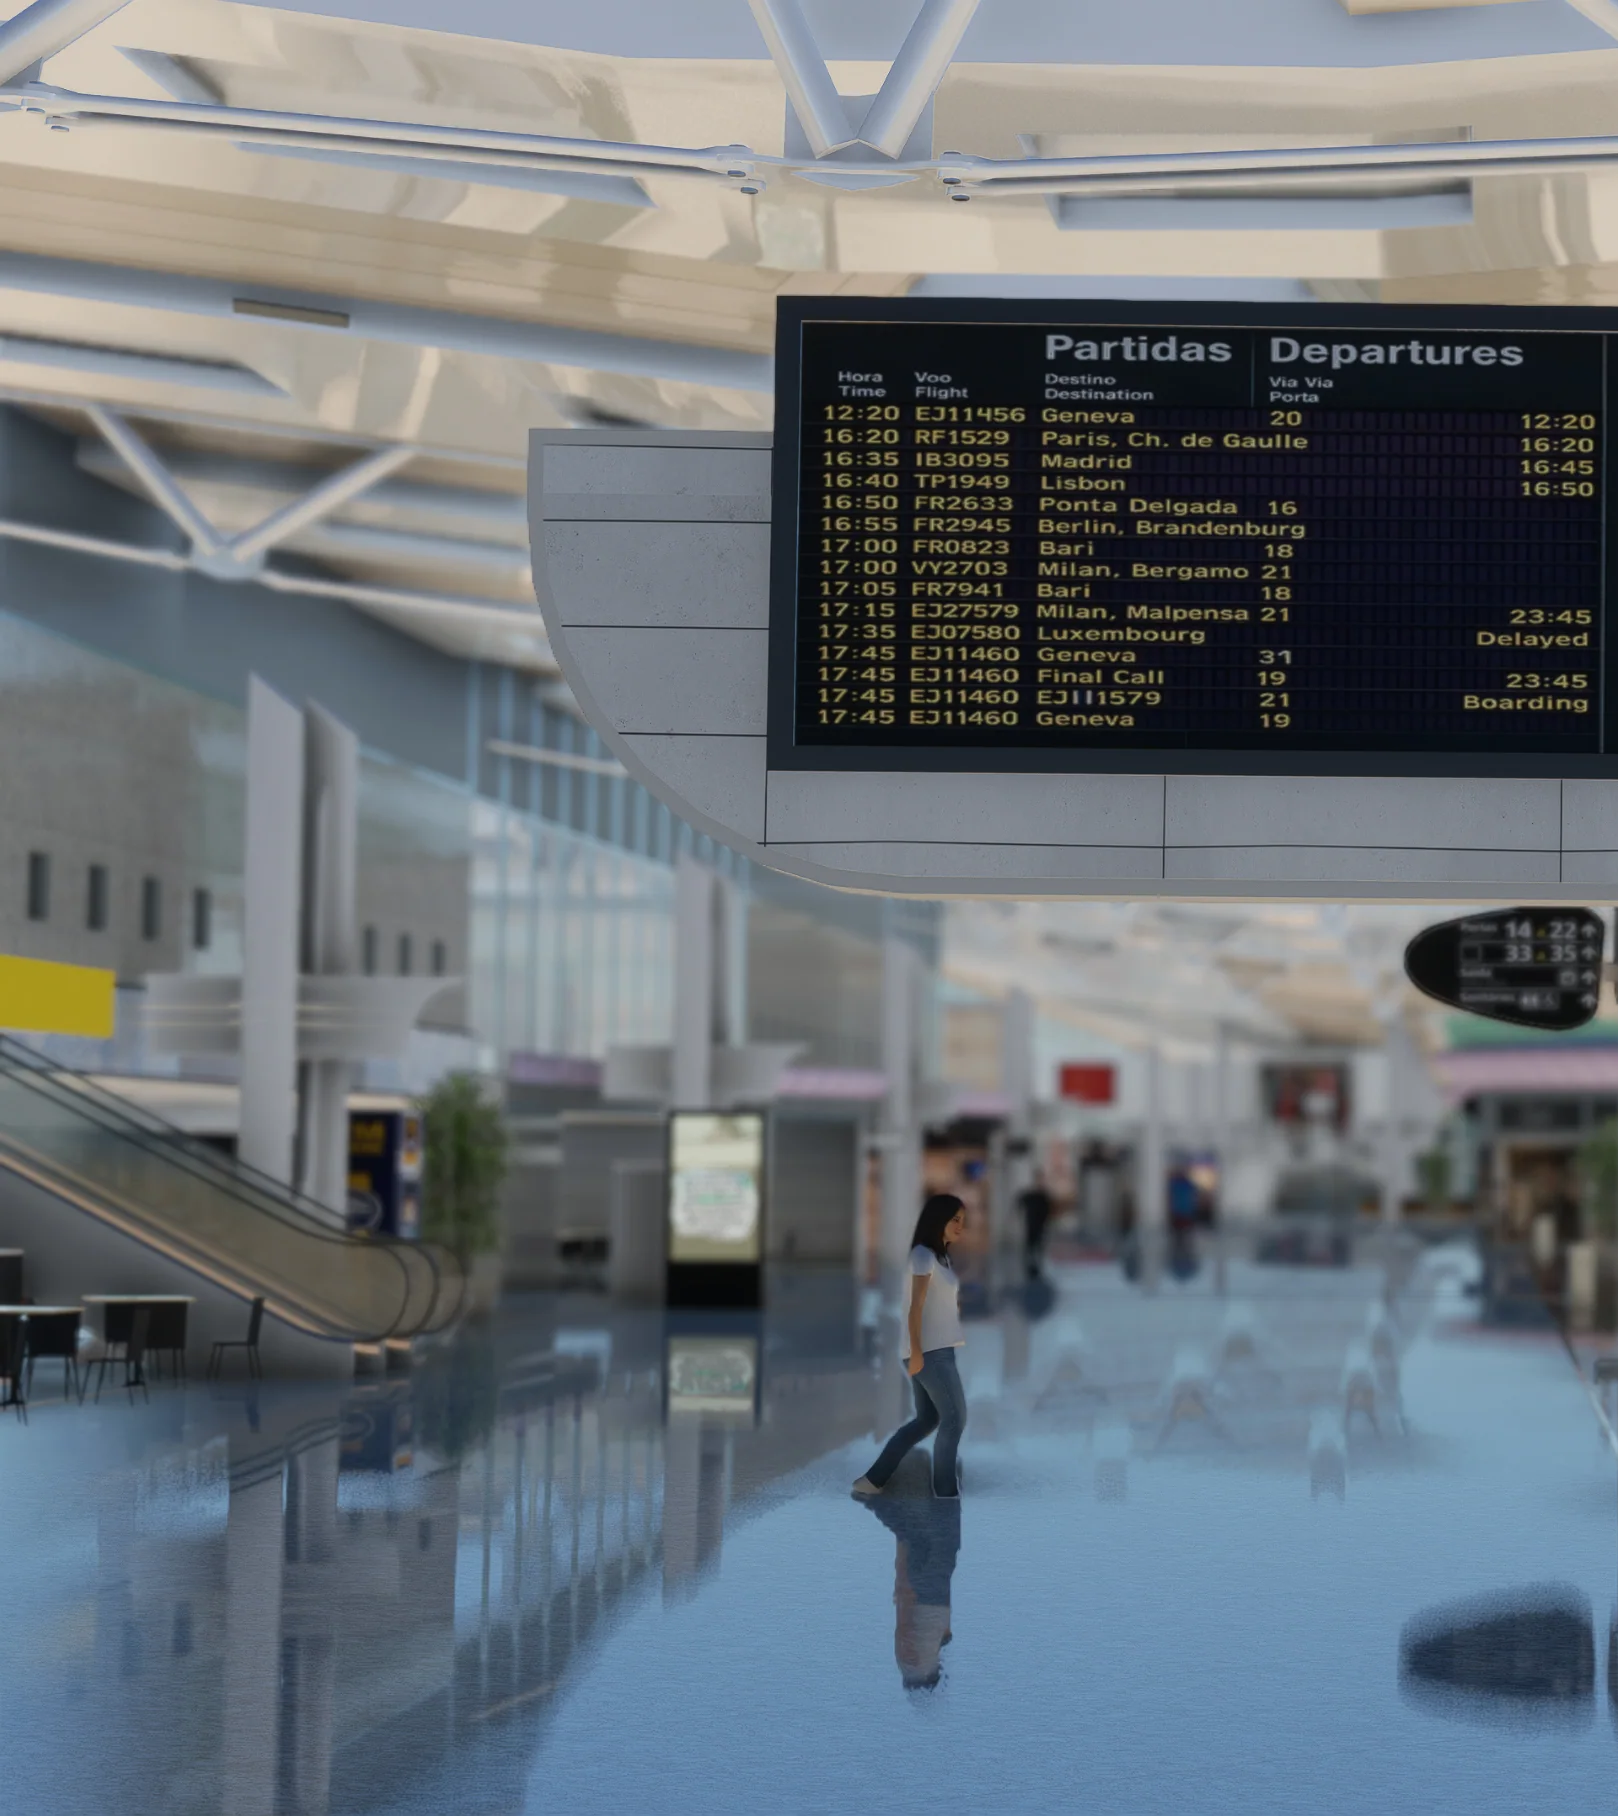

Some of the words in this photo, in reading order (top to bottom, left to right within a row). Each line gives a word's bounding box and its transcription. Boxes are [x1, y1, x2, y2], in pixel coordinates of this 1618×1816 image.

[1045, 334, 1232, 362] Partidas
[1269, 337, 1524, 370] Departures
[837, 371, 883, 383] Hora
[914, 372, 952, 383] Voo
[1044, 373, 1116, 385] Destino
[1268, 376, 1298, 388] Via
[1303, 377, 1334, 389] Via
[838, 385, 887, 398] Time
[914, 386, 968, 400] Flight
[1043, 388, 1154, 401] Destination
[1268, 391, 1319, 403] Porta
[824, 405, 900, 421] 12:20
[915, 406, 1025, 422] EJ11456
[1041, 407, 1134, 423] Geneva
[1270, 410, 1302, 426] 20
[1521, 414, 1595, 430] 12:20
[823, 428, 899, 444] 16:20
[914, 429, 1009, 445] RF1529
[1127, 432, 1169, 447] Ch.
[1180, 433, 1212, 447] de
[1222, 433, 1308, 449] Gaulle
[1520, 437, 1594, 453] 16:20
[822, 451, 899, 466] 16:35
[915, 452, 1009, 467] IB3095
[1040, 454, 1131, 469] Madrid
[1520, 459, 1593, 475] 16:45
[823, 473, 899, 488] 16:40
[913, 474, 1009, 489] TP1949
[1040, 476, 1125, 491] Lisbon
[1521, 481, 1593, 497] 16:50
[823, 495, 898, 510] 16:50
[914, 496, 1013, 511] FR2633
[1039, 497, 1117, 512] Ponta
[1129, 498, 1238, 516] Delgada
[1267, 501, 1297, 515] 16
[822, 516, 898, 531] 16:55
[913, 517, 1011, 533] FR2945
[1037, 519, 1125, 537] Berlin,
[1135, 520, 1305, 539] Brandenburg
[821, 539, 897, 554] 17:00
[913, 539, 1009, 554] FR0823
[1039, 541, 1093, 555] Bari
[1264, 544, 1293, 558] 18
[820, 560, 897, 575] 17:00
[911, 561, 1008, 576] VY2703
[1037, 562, 1119, 579] Milan,
[1131, 563, 1249, 580] Bergamo
[1261, 565, 1290, 579] 21
[819, 602, 895, 617] 17:15
[910, 603, 1019, 618] EJ27579
[1036, 604, 1115, 621] Milan,
[1126, 605, 1248, 621] Malpensa
[1260, 607, 1288, 622] 21
[1510, 609, 1591, 625] 23:45
[820, 624, 896, 639] 17:35
[910, 624, 1020, 640] EJ07580
[1037, 626, 1205, 645] Luxembourg
[1476, 631, 1588, 649] Delayed
[818, 646, 895, 660] 17:45
[910, 646, 1020, 662] EJ11460
[1037, 647, 1136, 662] Geneva
[1259, 650, 1291, 664] 31
[819, 667, 895, 682] 17:45
[909, 668, 1019, 683] EJ11460
[1037, 669, 1101, 684] Final
[1112, 670, 1163, 684] Call
[1258, 671, 1286, 685] 19
[1506, 673, 1588, 689] 23:45
[819, 688, 895, 703] 17:45
[909, 689, 1019, 704] EJ11460
[1259, 692, 1288, 707] 21
[1463, 695, 1588, 713] Boarding
[1550, 921, 1576, 938] 22
